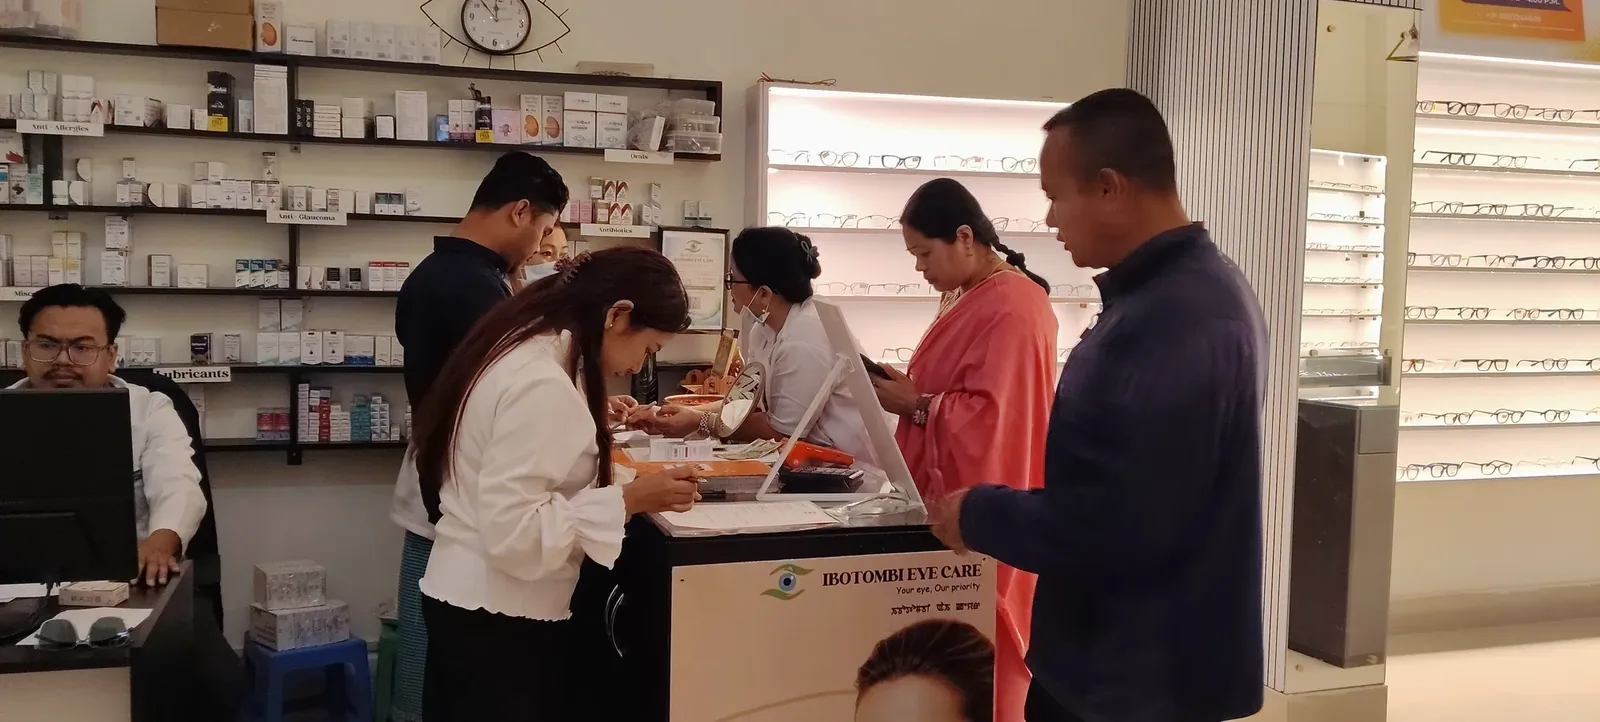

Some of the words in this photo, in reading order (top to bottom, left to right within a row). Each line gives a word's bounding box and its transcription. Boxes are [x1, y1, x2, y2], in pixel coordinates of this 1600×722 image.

[469, 13, 475, 21] 9
[518, 20, 524, 28] 3
[492, 38, 498, 47] 6
[54, 124, 89, 132] Allergies
[298, 213, 336, 221] Glaucoma
[598, 226, 633, 234] Antibiotics
[156, 369, 229, 379] ubricants
[822, 568, 904, 587] IBOTOMBI
[907, 566, 939, 581] EYE
[941, 563, 982, 579] CARE
[896, 586, 915, 595] Your
[916, 586, 933, 595] eye,
[934, 584, 950, 592] Our
[951, 582, 981, 593] priority
